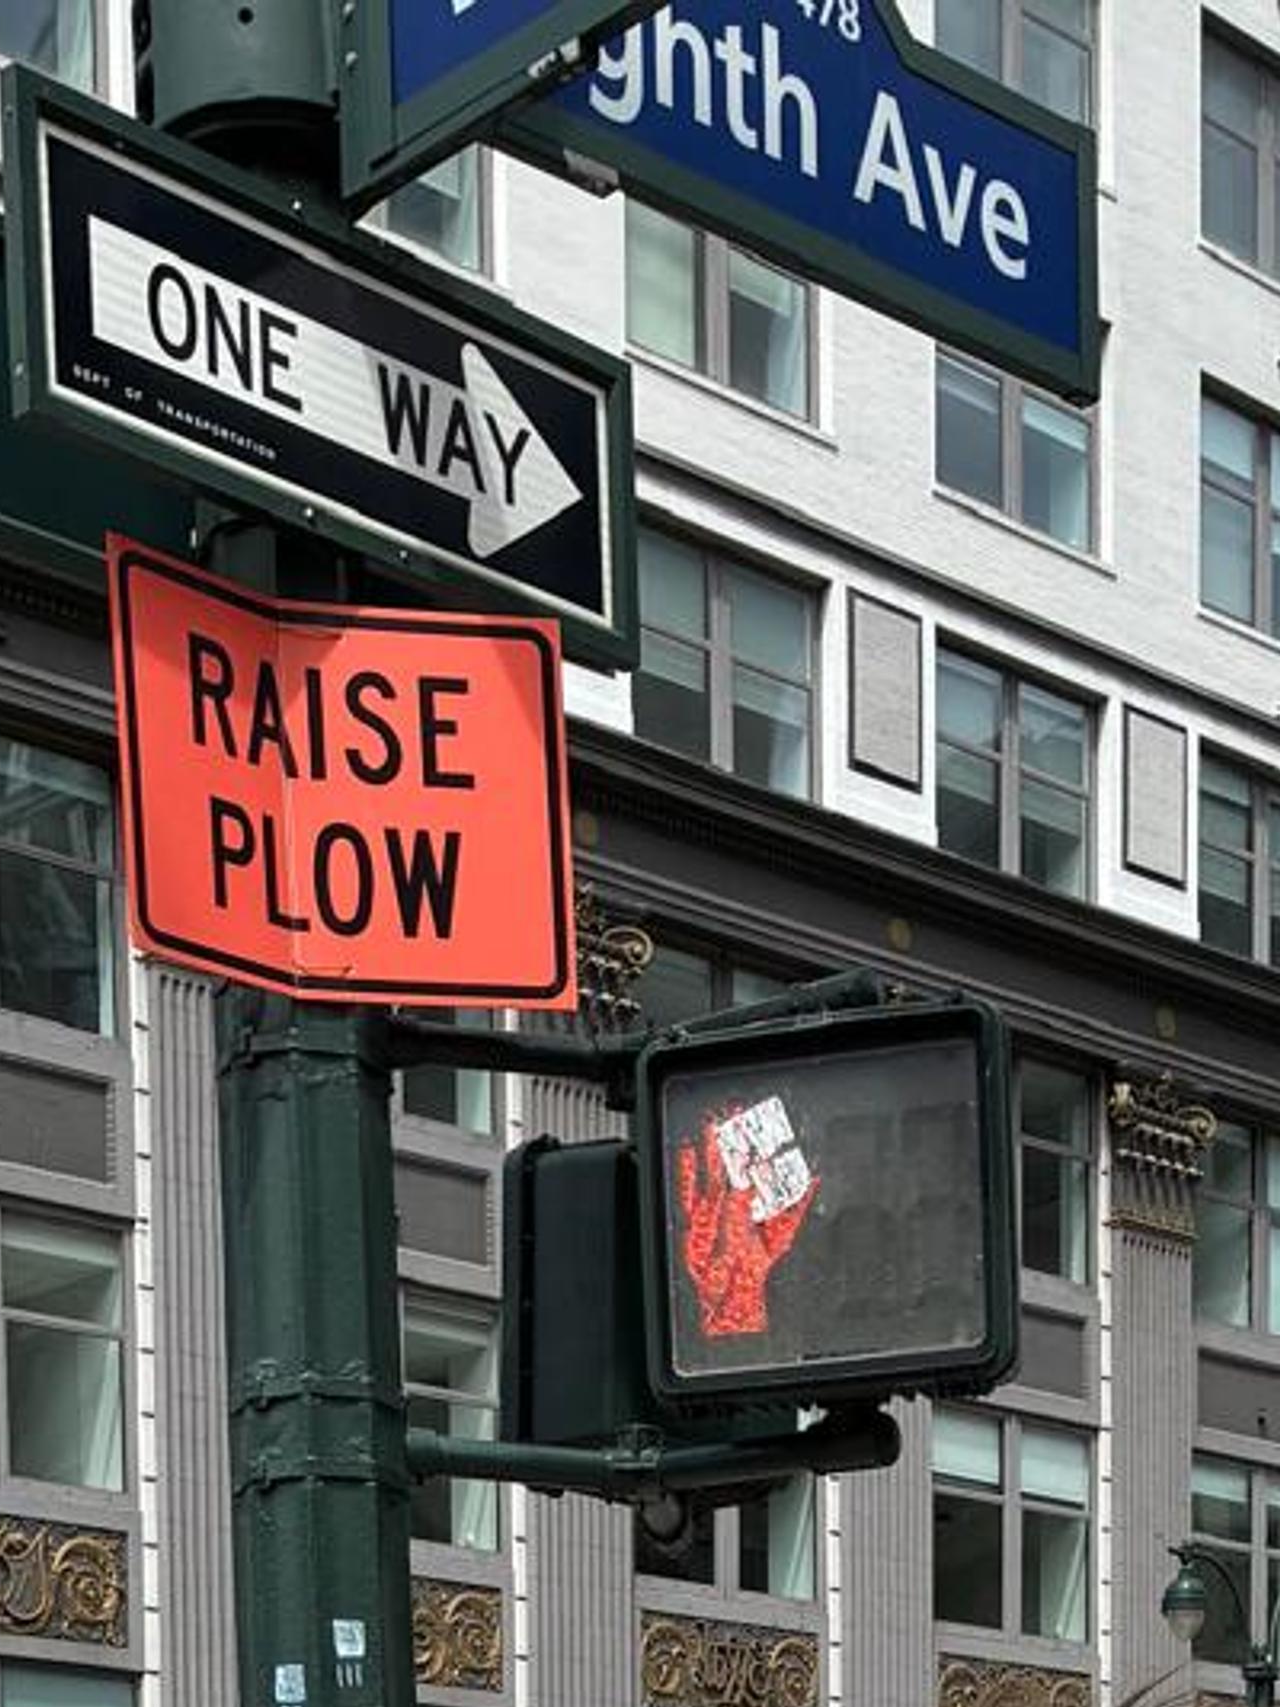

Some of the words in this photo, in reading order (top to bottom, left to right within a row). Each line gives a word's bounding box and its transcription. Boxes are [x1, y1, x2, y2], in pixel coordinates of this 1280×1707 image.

[589, 5, 818, 179] ghth
[853, 91, 1030, 280] Ave
[148, 263, 303, 414] ONE
[378, 362, 532, 504] WAY
[156, 400, 277, 460] TRANSPORTATION
[187, 631, 475, 790] RAISE
[209, 794, 462, 940] PLOW
